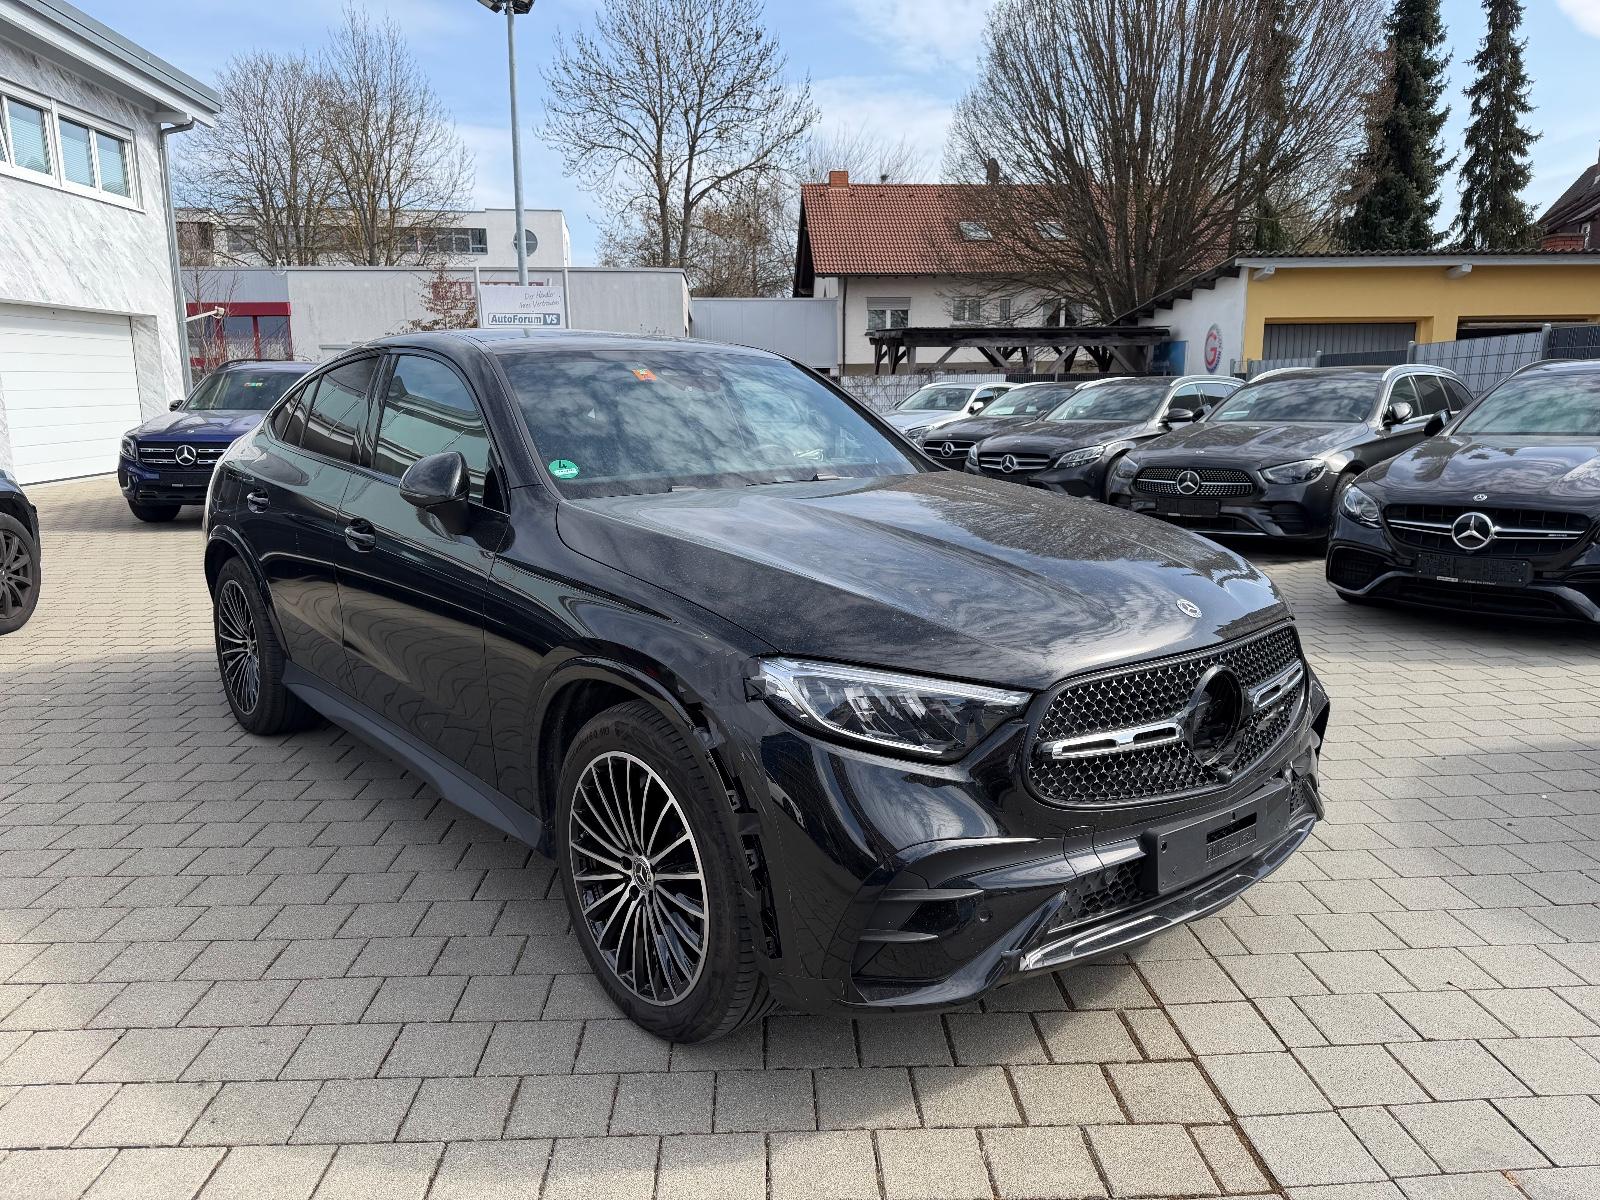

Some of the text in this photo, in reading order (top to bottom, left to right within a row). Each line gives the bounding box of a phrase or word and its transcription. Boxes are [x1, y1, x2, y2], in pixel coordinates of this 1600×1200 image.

[490, 314, 558, 324] AutoForum VS
[1206, 331, 1217, 367] G
[558, 460, 568, 469] 4
